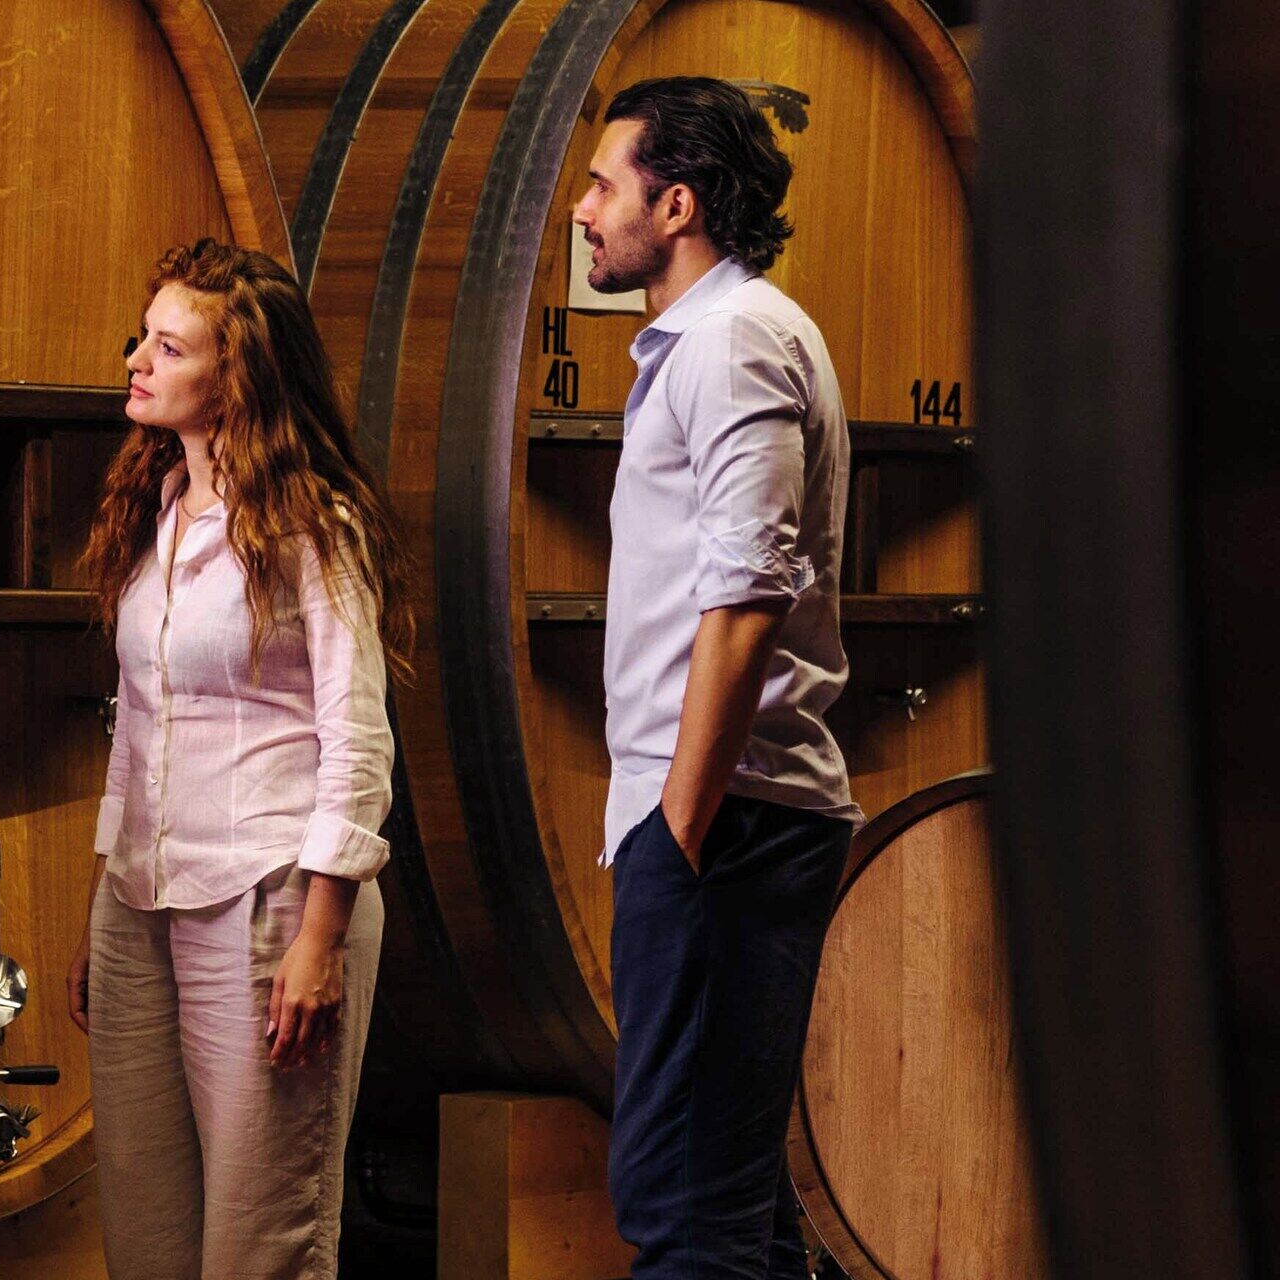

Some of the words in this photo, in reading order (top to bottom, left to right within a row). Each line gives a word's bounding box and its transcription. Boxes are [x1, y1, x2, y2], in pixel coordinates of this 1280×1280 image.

[543, 306, 572, 356] HL
[543, 360, 579, 409] 40
[910, 379, 962, 426] 144
